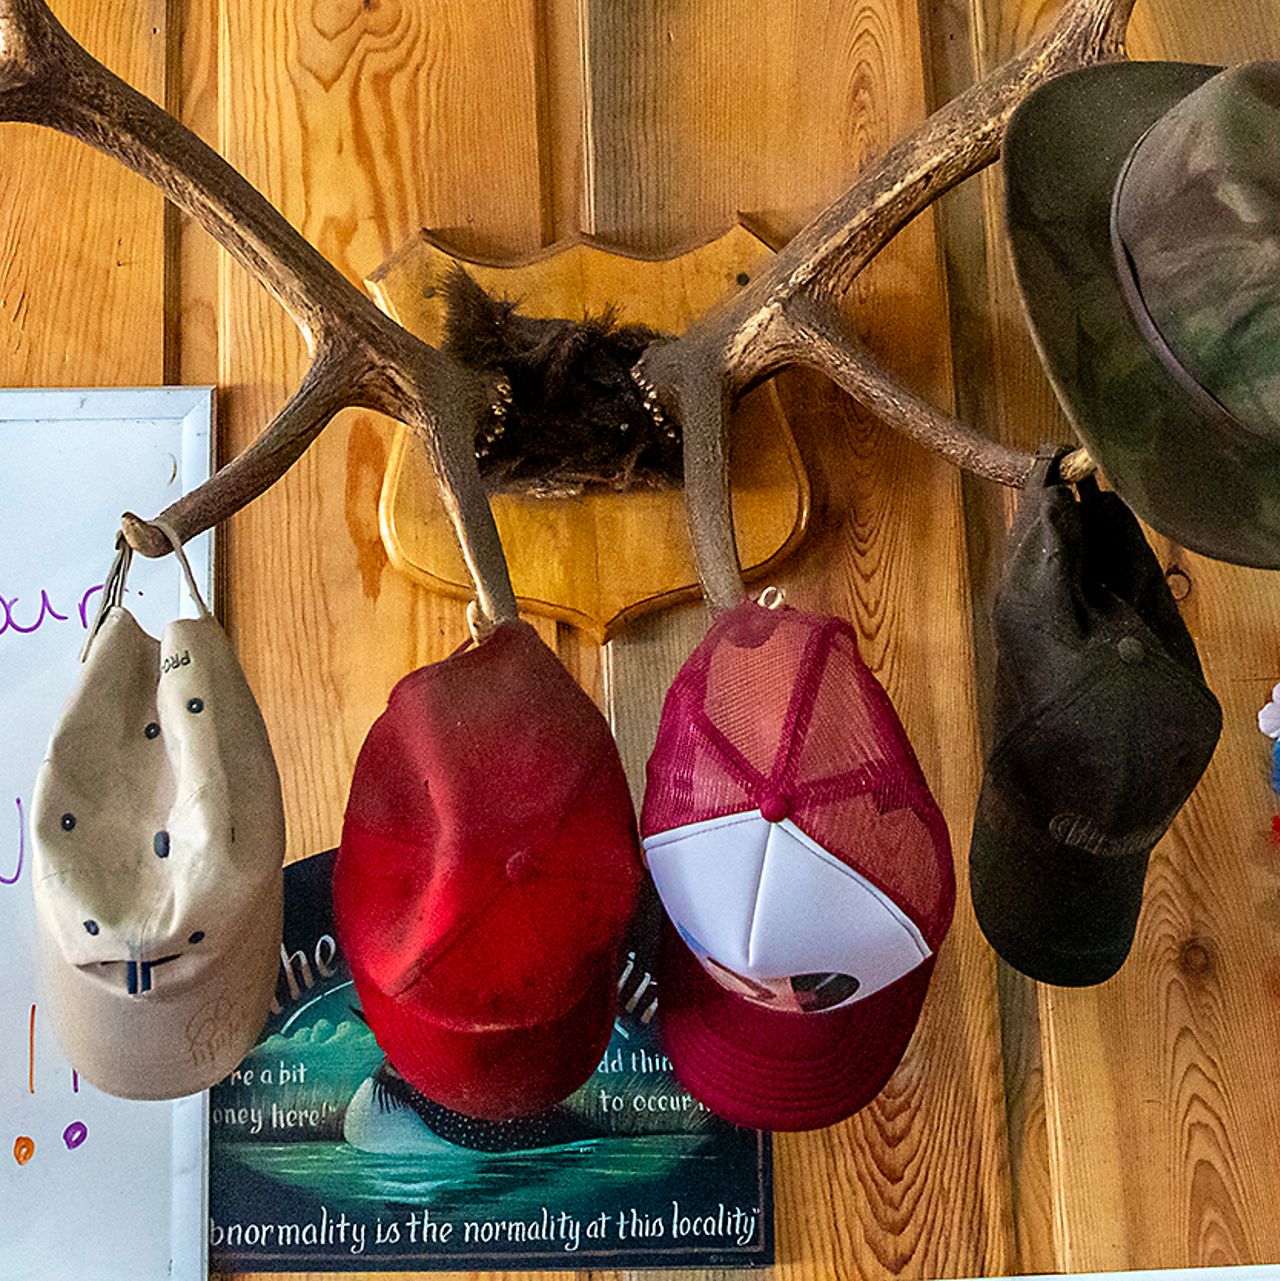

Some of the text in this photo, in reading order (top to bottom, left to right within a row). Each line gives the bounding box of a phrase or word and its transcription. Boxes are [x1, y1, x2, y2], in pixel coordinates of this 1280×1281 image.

[260, 1069, 273, 1085] a
[279, 1060, 308, 1086] bit
[597, 1048, 624, 1074] dd
[598, 1089, 625, 1113] to
[633, 1093, 692, 1113] occur
[212, 1106, 263, 1135] oney
[210, 1206, 367, 1255] bnormality
[375, 1213, 401, 1244] is
[406, 1209, 454, 1243] the
[463, 1207, 581, 1251] normality
[586, 1211, 612, 1241] at
[616, 1208, 665, 1239] this
